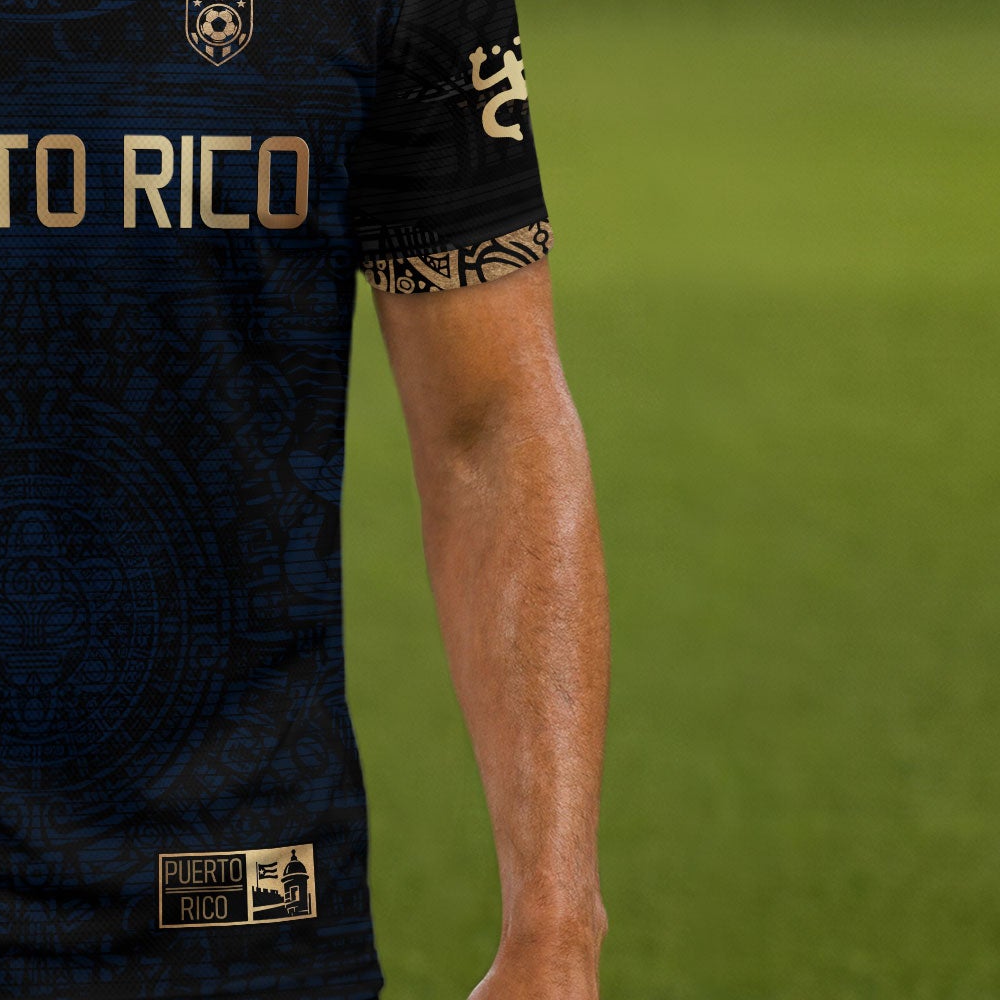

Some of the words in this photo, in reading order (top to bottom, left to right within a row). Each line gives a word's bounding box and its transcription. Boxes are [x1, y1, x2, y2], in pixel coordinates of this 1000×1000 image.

[124, 134, 310, 230] RICO
[164, 857, 243, 885] PUERTO
[180, 895, 228, 921] RICO
